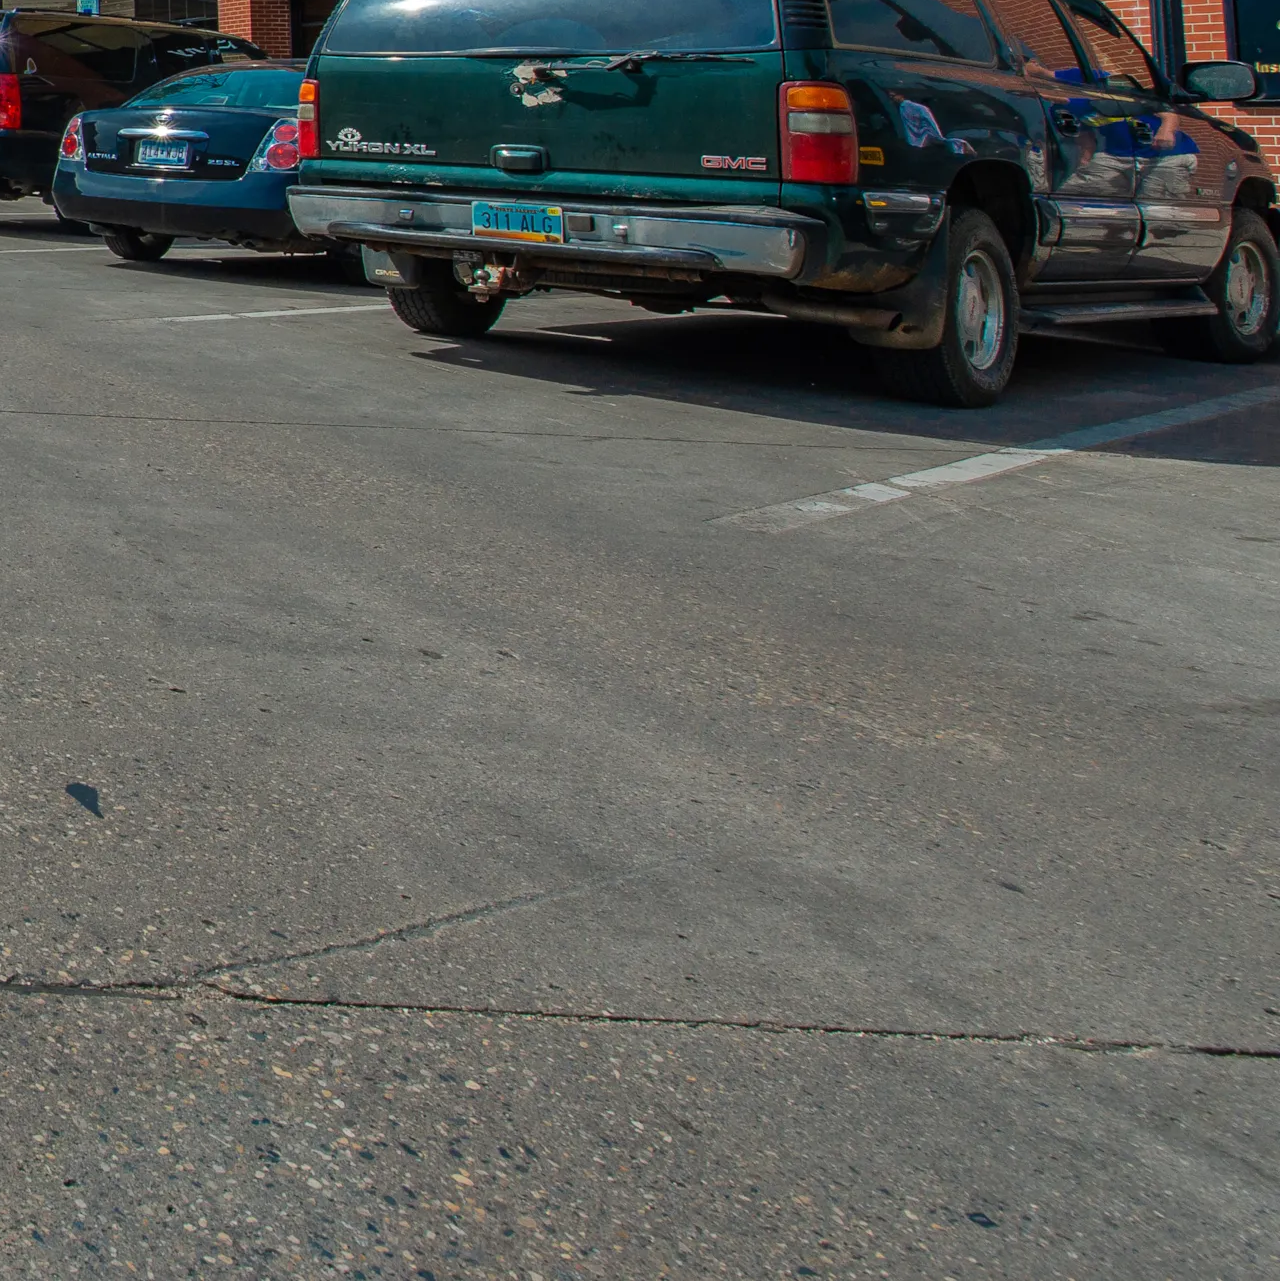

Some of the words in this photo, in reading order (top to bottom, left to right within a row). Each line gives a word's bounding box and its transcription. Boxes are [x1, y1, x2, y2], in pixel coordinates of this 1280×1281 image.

[87, 151, 117, 160] ALTIMA
[326, 139, 400, 154] YUKON
[403, 142, 437, 157] XL
[700, 154, 767, 170] GMC
[480, 211, 510, 231] 311
[520, 214, 553, 234] ALG
[374, 268, 400, 278] GMC
